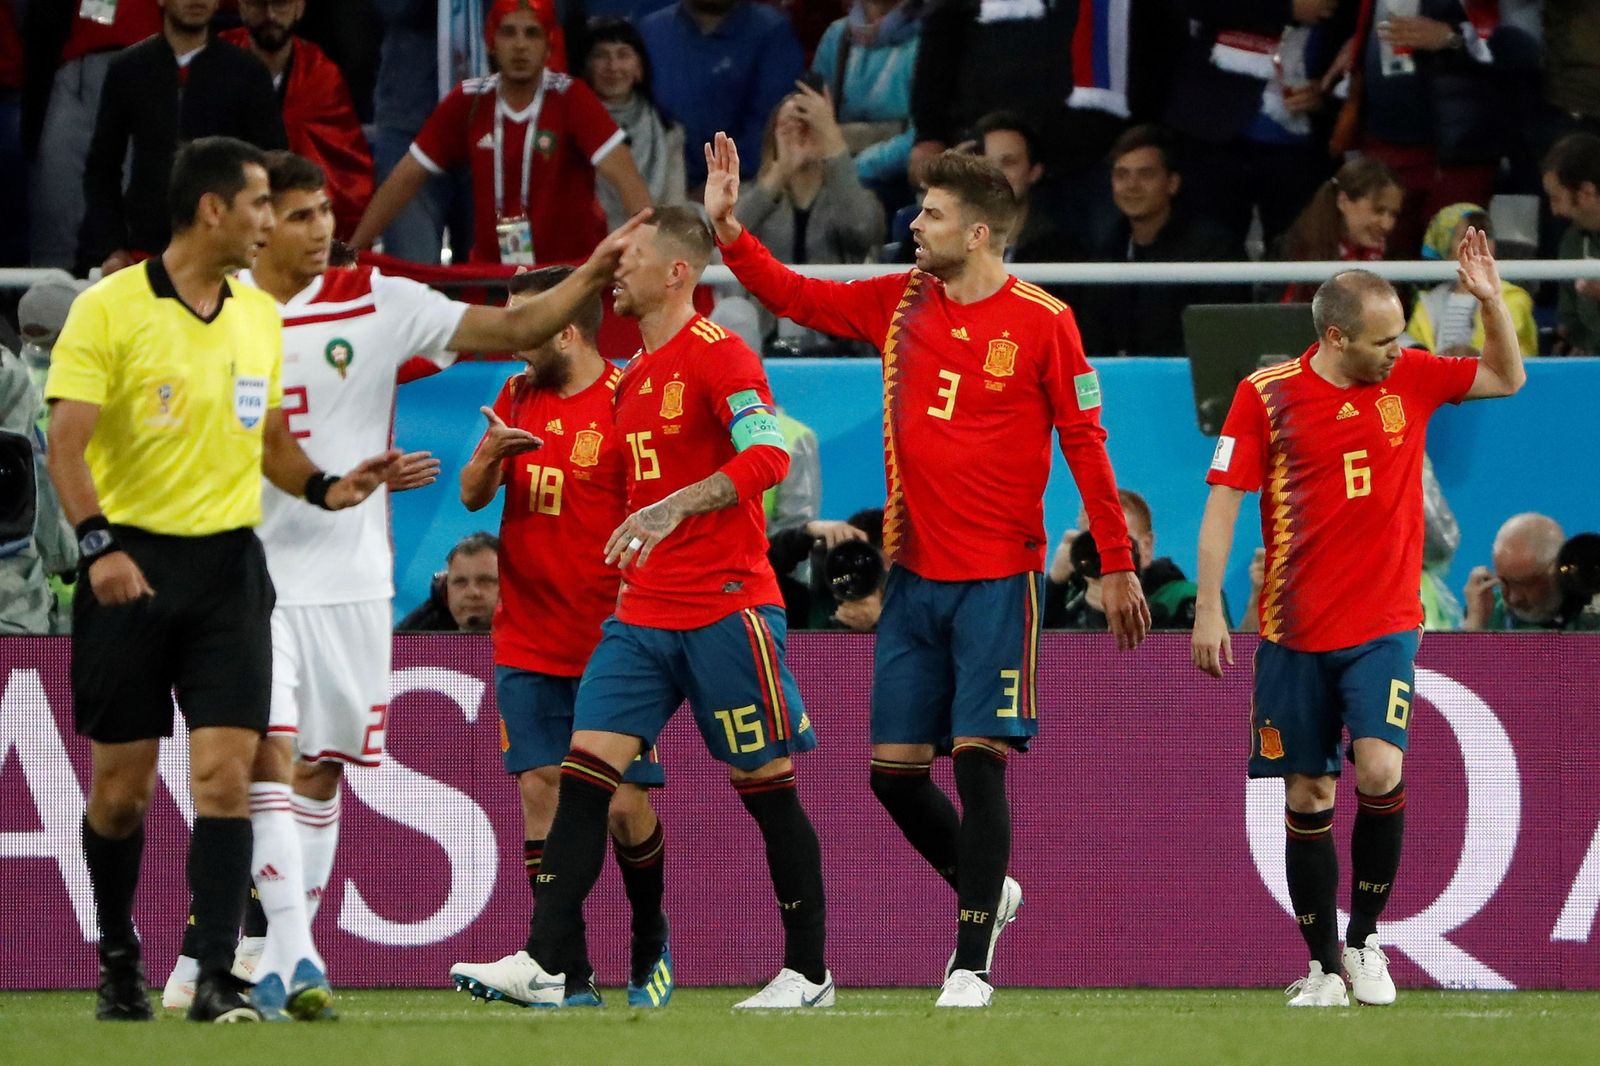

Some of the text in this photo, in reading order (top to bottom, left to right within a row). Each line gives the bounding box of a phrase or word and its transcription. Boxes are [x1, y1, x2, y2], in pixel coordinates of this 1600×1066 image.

[238, 395, 261, 408] FIFA
[282, 385, 311, 439] 2
[927, 369, 961, 421] 3
[626, 431, 661, 481] 15
[1343, 449, 1372, 499] 6
[527, 464, 564, 516] 18
[996, 669, 1020, 718] 3
[1385, 678, 1411, 730] 6
[361, 704, 388, 756] 2
[714, 703, 765, 754] 15
[1245, 667, 1600, 990] Q
